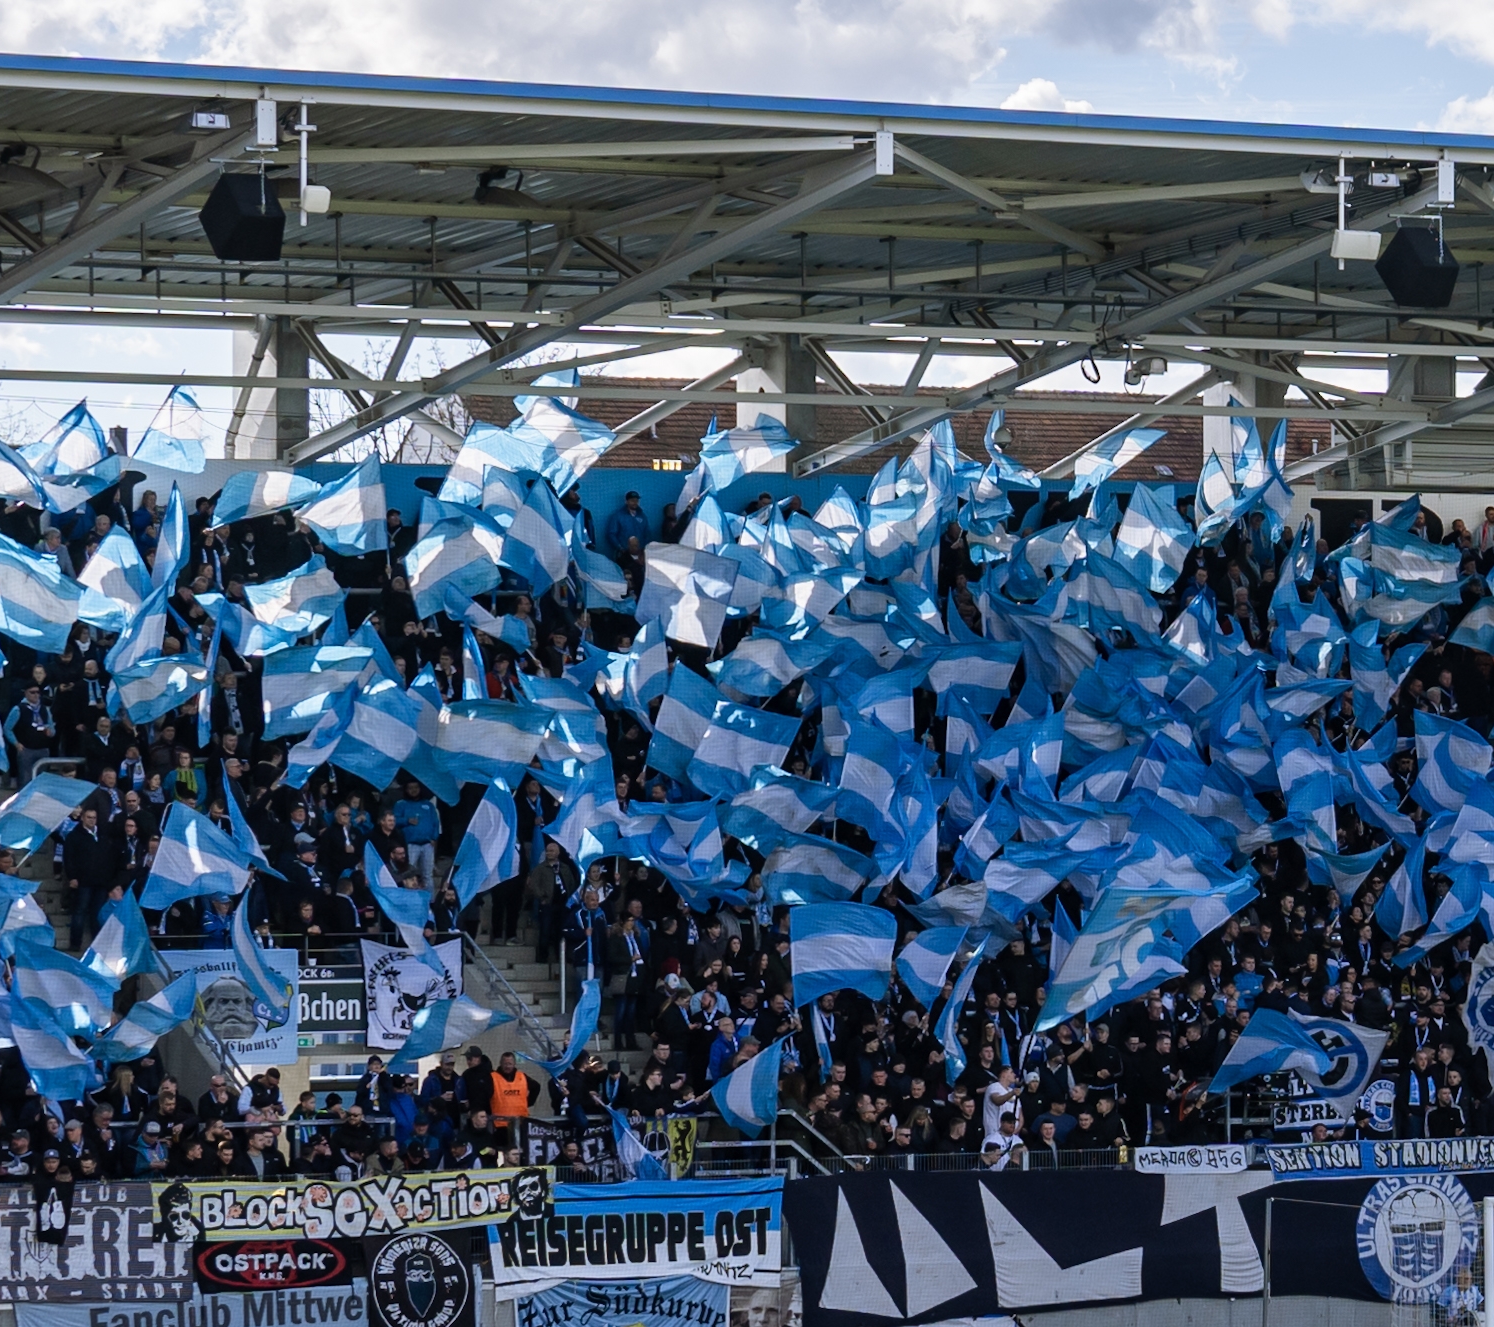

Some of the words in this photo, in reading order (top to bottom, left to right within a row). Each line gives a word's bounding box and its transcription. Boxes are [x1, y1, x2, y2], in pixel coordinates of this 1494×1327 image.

[1274, 1103, 1344, 1126] STERB
[81, 1182, 129, 1204] LUB
[497, 1211, 706, 1268] REISEGRUPPE
[715, 1207, 771, 1258] OST
[102, 1281, 185, 1301] STADT
